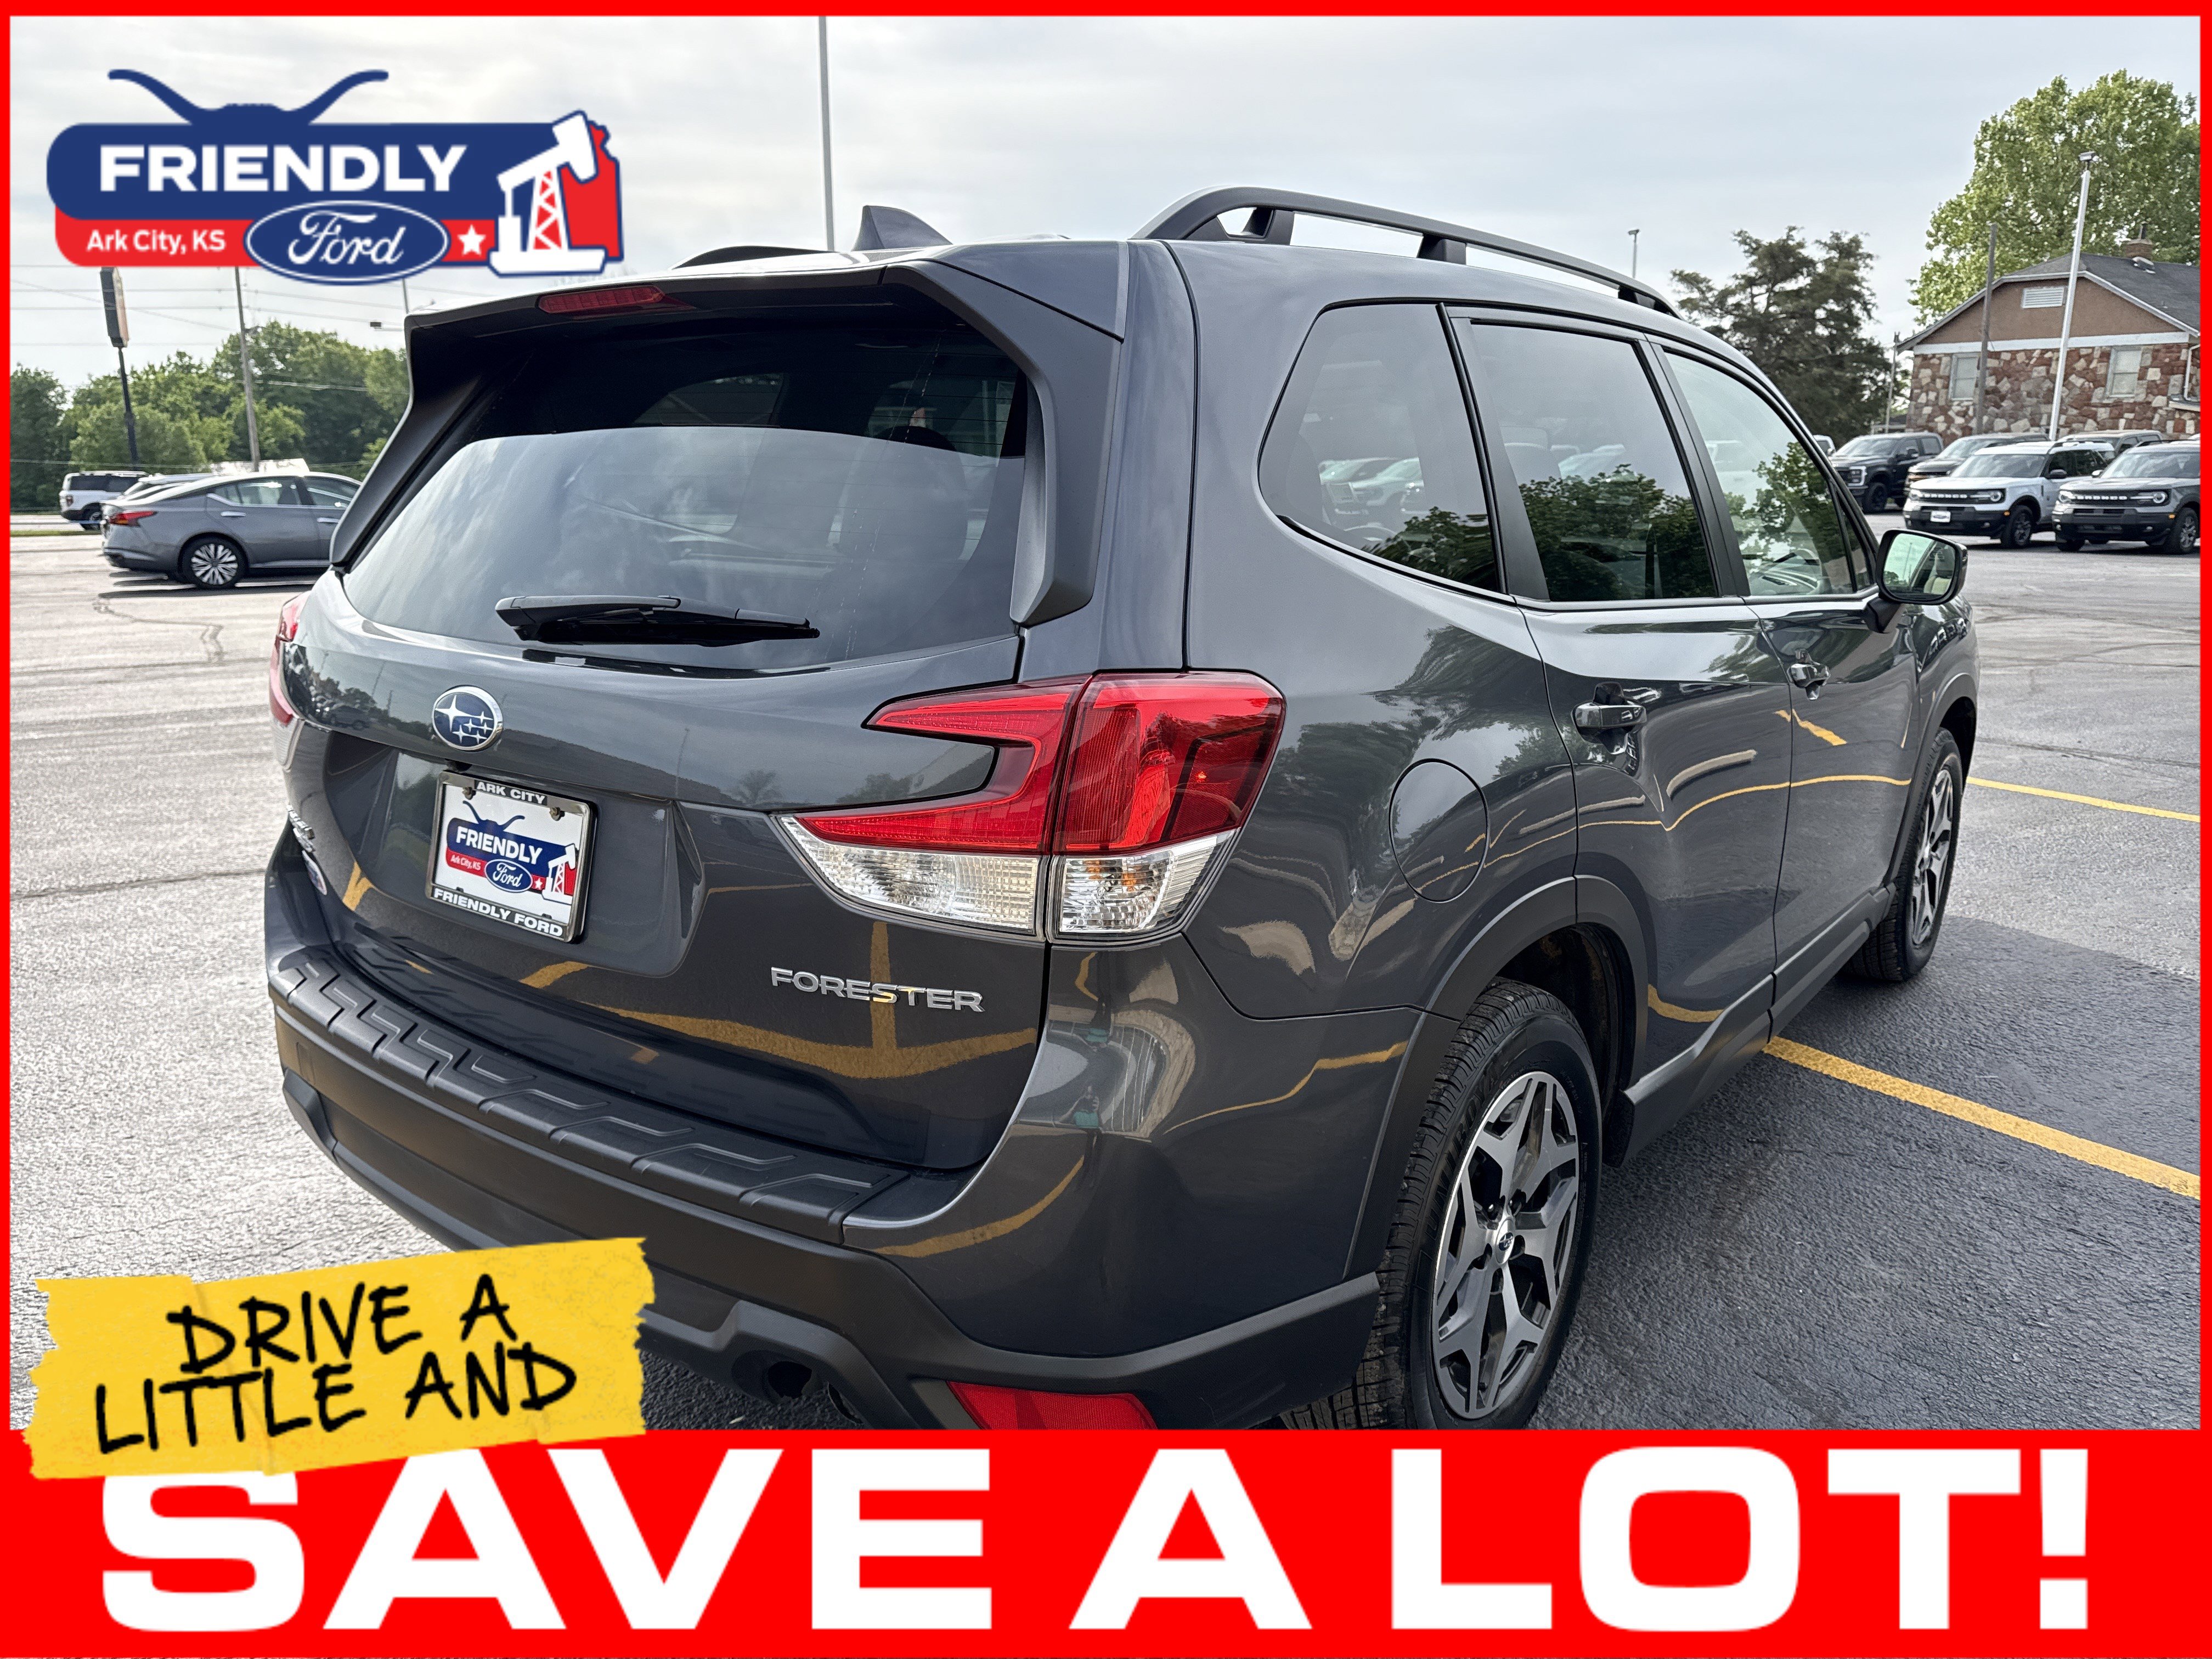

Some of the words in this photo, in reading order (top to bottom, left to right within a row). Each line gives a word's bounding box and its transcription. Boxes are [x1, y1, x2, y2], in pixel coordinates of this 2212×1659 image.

[476, 781, 506, 797] ARK
[510, 788, 546, 804] CITY
[456, 825, 543, 865] FRIENDLY
[492, 862, 523, 888] Ford
[433, 889, 511, 921] FRIENDLY
[514, 912, 563, 937] FORD
[771, 966, 986, 1013] FORESTER
